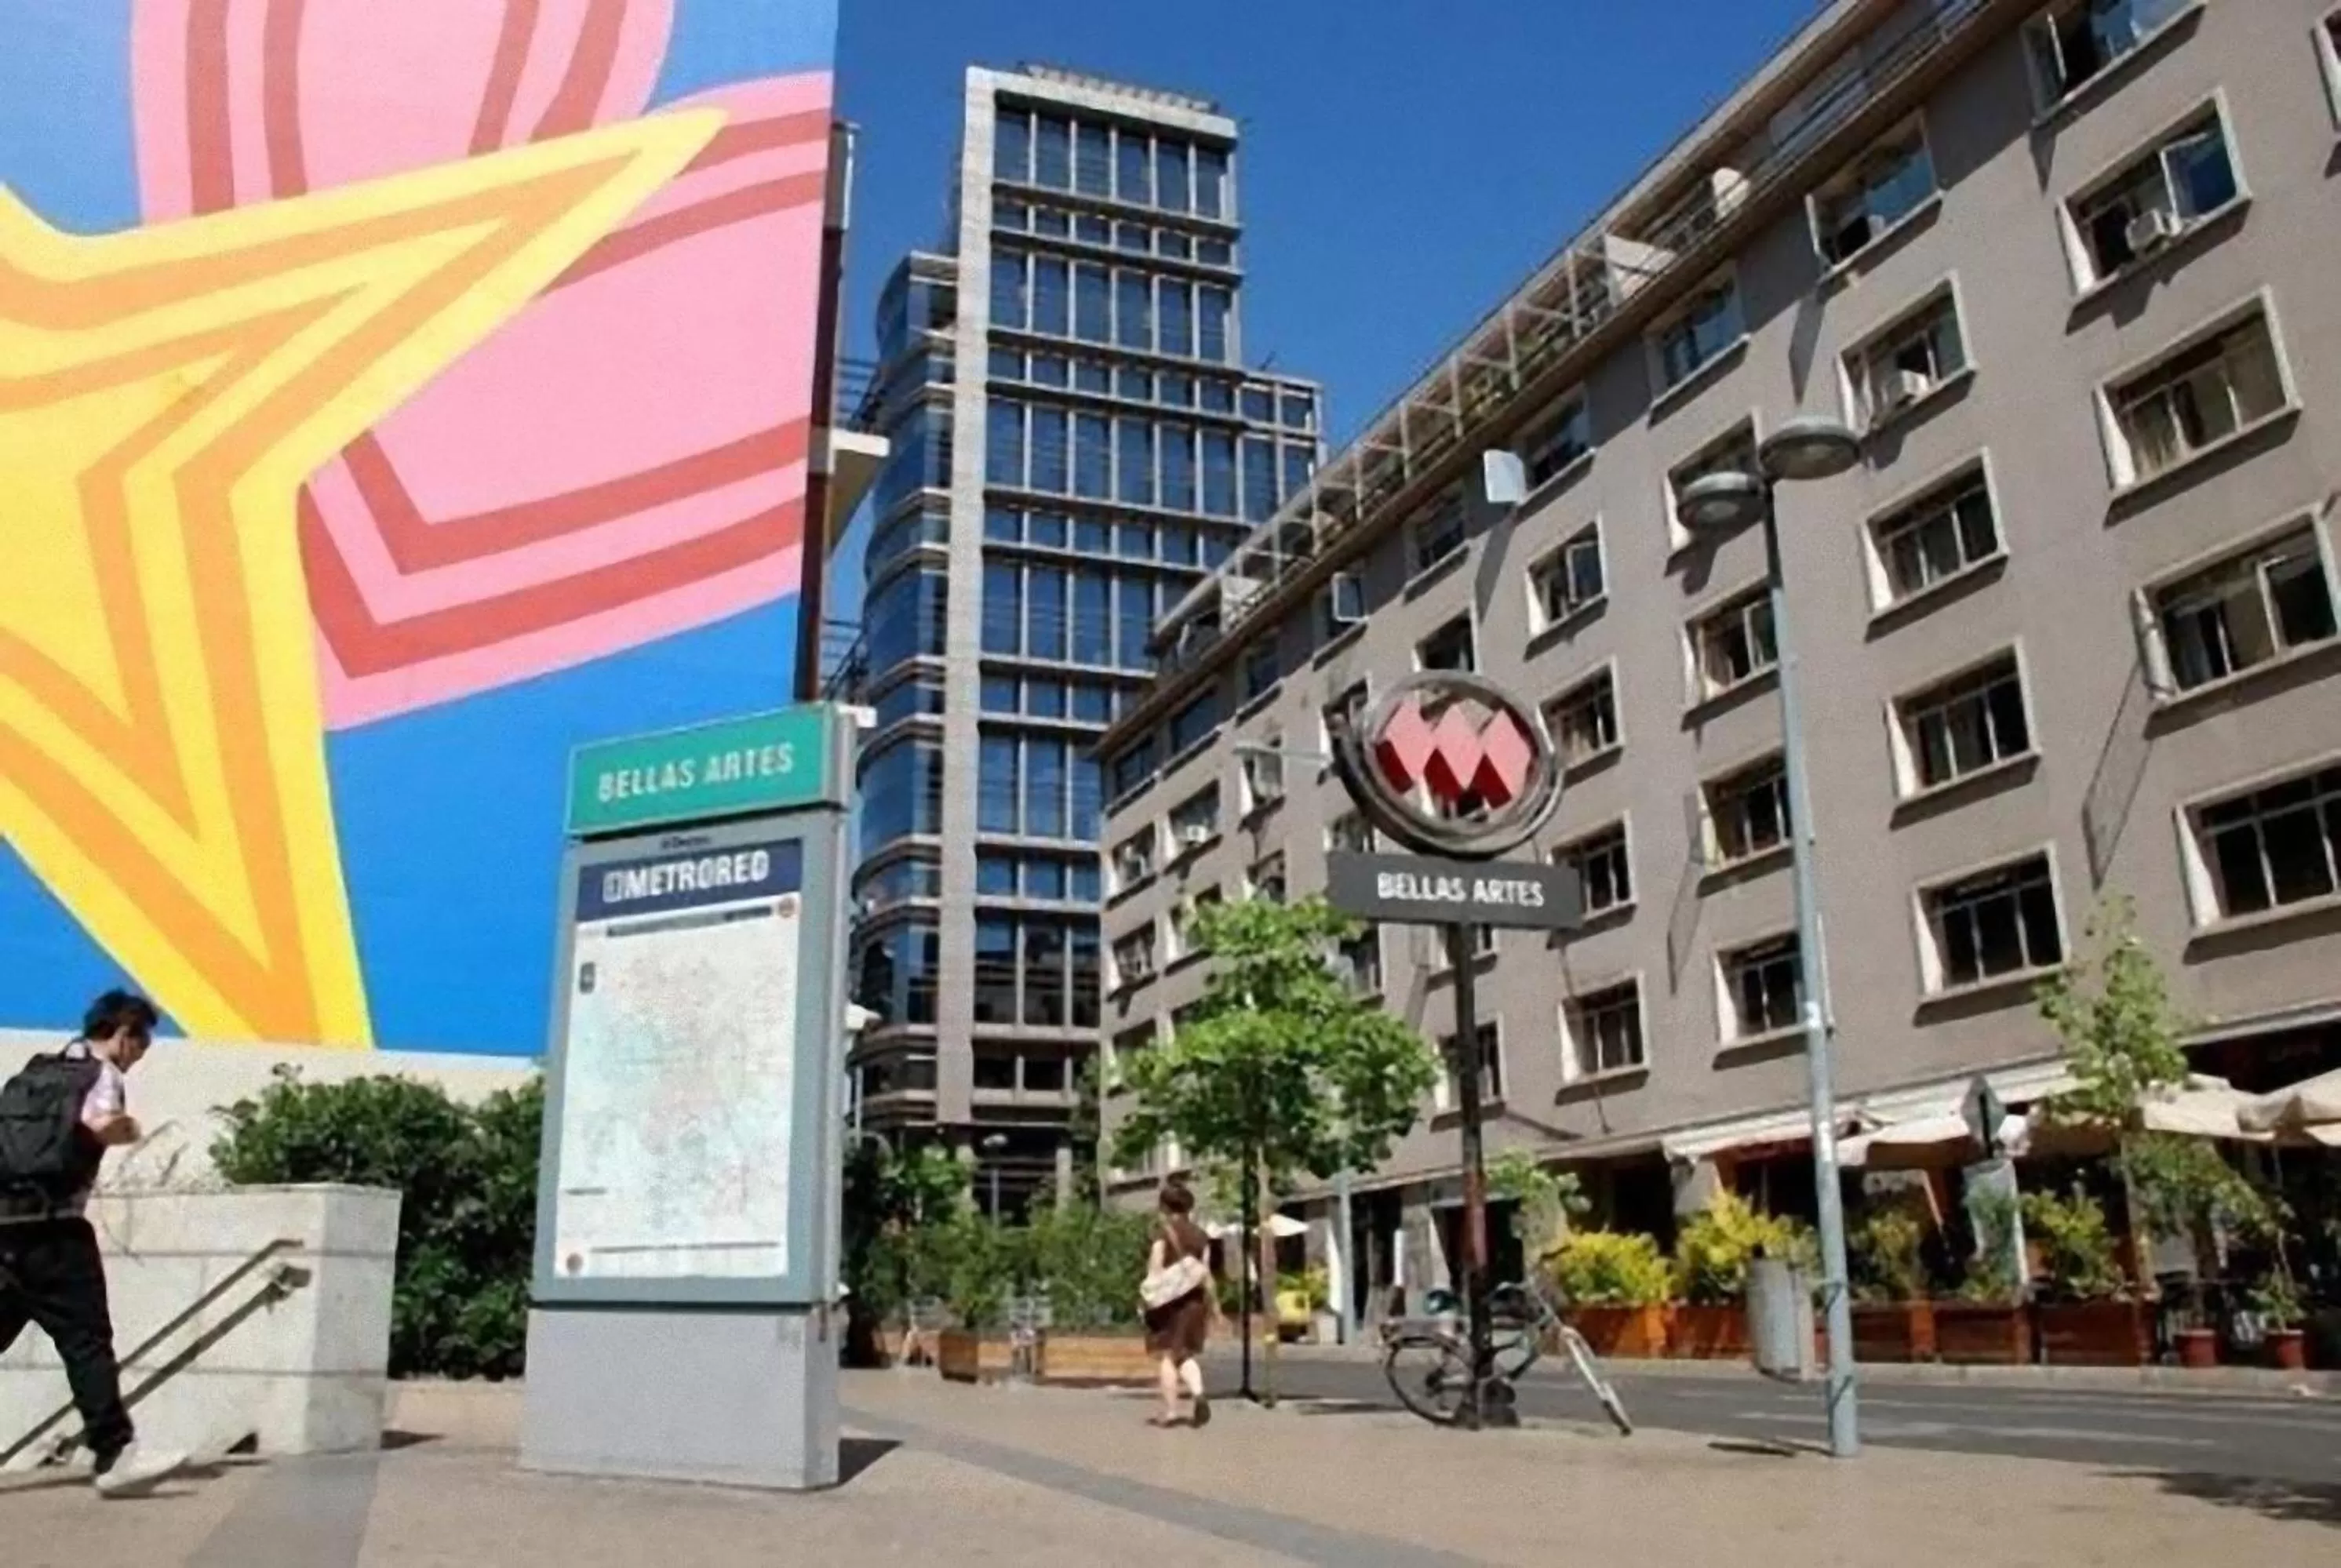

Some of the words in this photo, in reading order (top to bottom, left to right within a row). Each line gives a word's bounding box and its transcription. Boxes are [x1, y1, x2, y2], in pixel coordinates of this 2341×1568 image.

[598, 758, 697, 802] BELLAS
[704, 742, 795, 783] ARTES
[1377, 871, 1466, 901] BELLAS
[1473, 878, 1545, 908] ARTES
